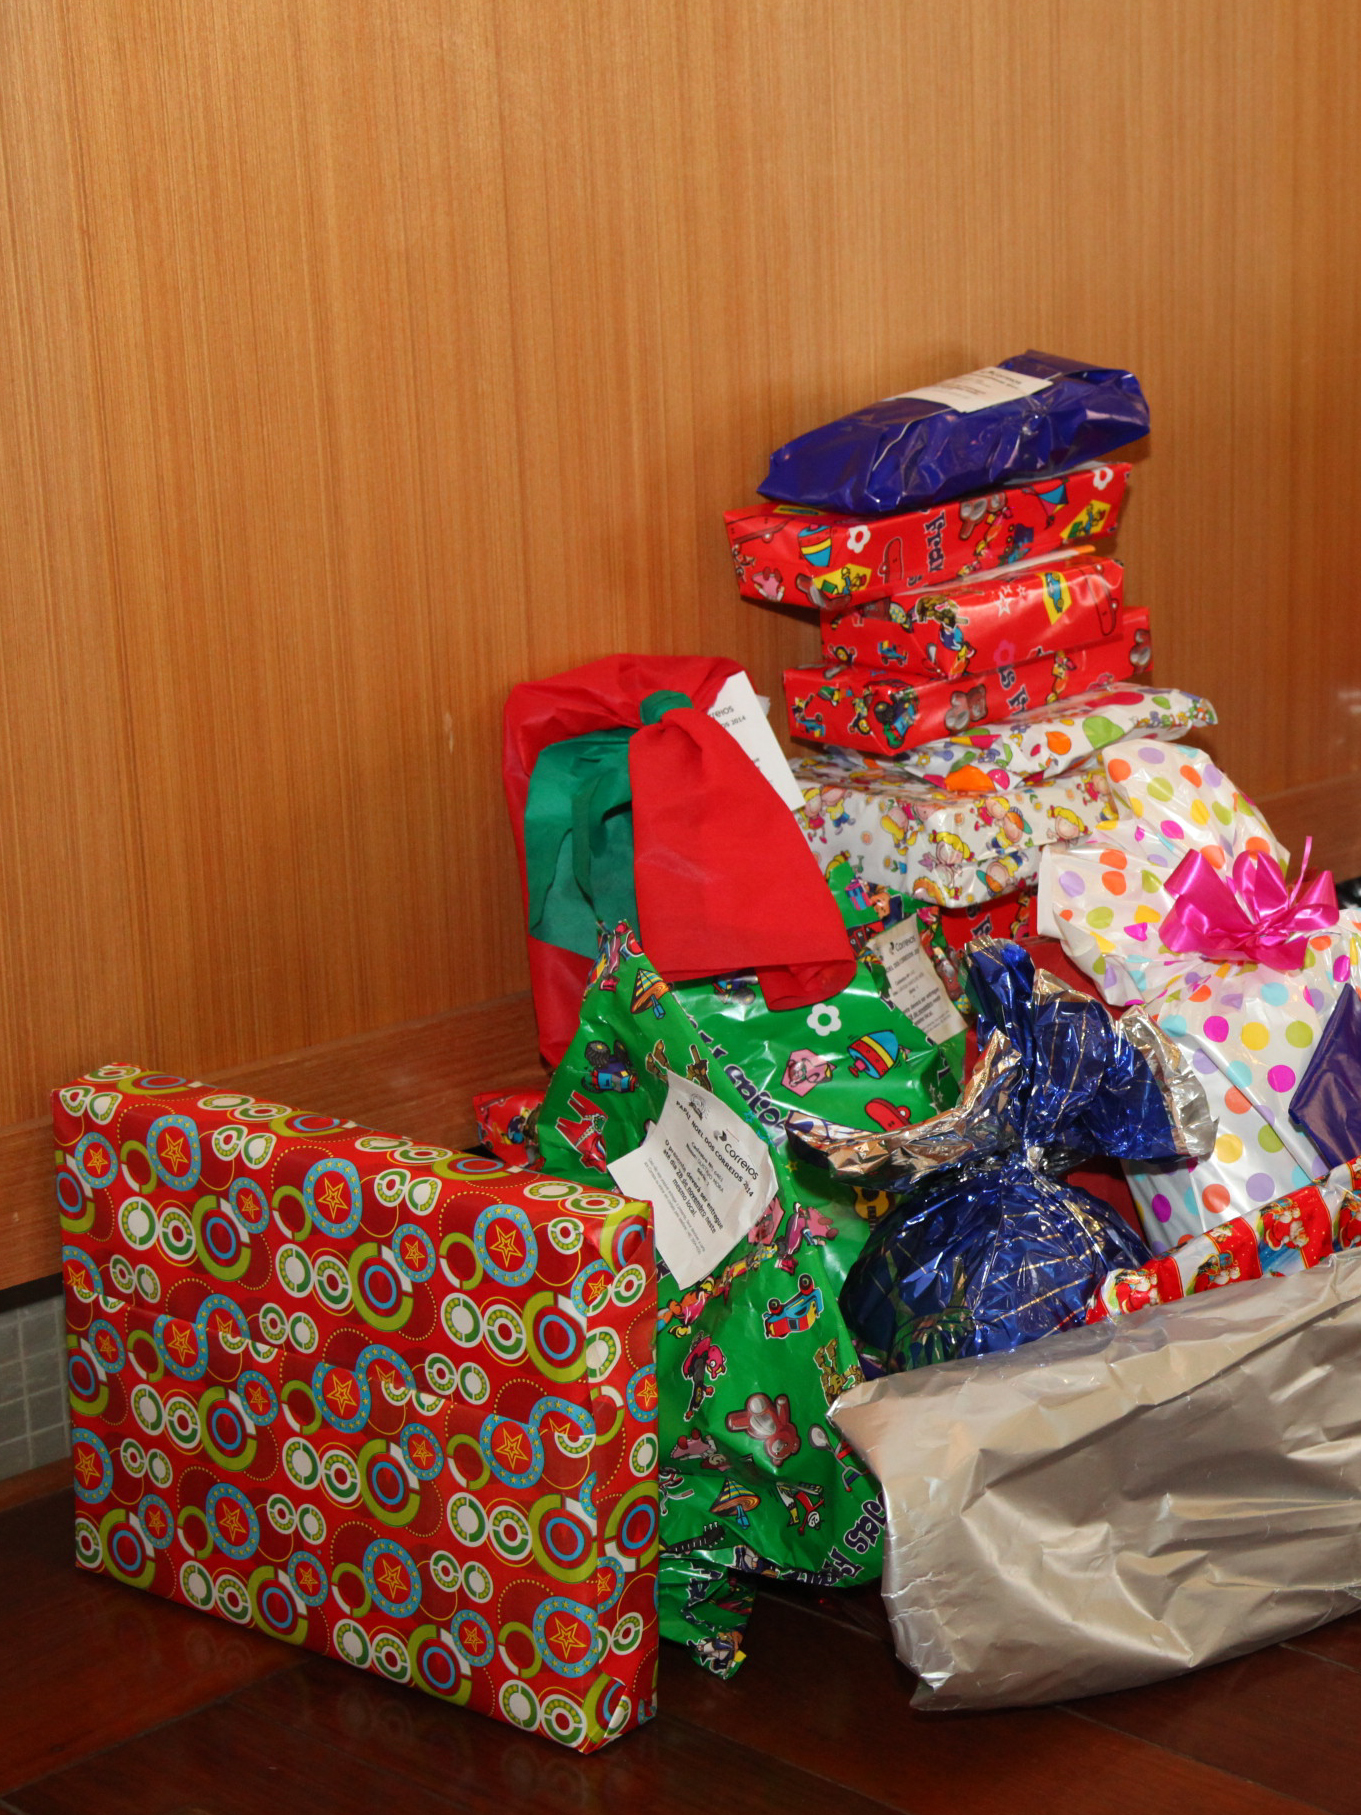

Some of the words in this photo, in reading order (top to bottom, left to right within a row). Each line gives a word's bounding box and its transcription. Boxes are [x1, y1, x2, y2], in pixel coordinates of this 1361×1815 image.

[674, 1100, 691, 1120] PAPAI
[690, 1120, 705, 1138] NOEL
[703, 1137, 716, 1152] DOS
[714, 1149, 743, 1183] CORREIOS
[723, 1141, 759, 1182] Correios
[669, 1159, 677, 1170] dia
[684, 1186, 708, 1217] novembro
[703, 1216, 717, 1234] neste
[671, 1177, 688, 1201] mesmo
[684, 1170, 702, 1193] deverá
[699, 1191, 708, 1203] ser
[704, 1201, 726, 1230] entregue
[843, 1488, 887, 1556] jas
